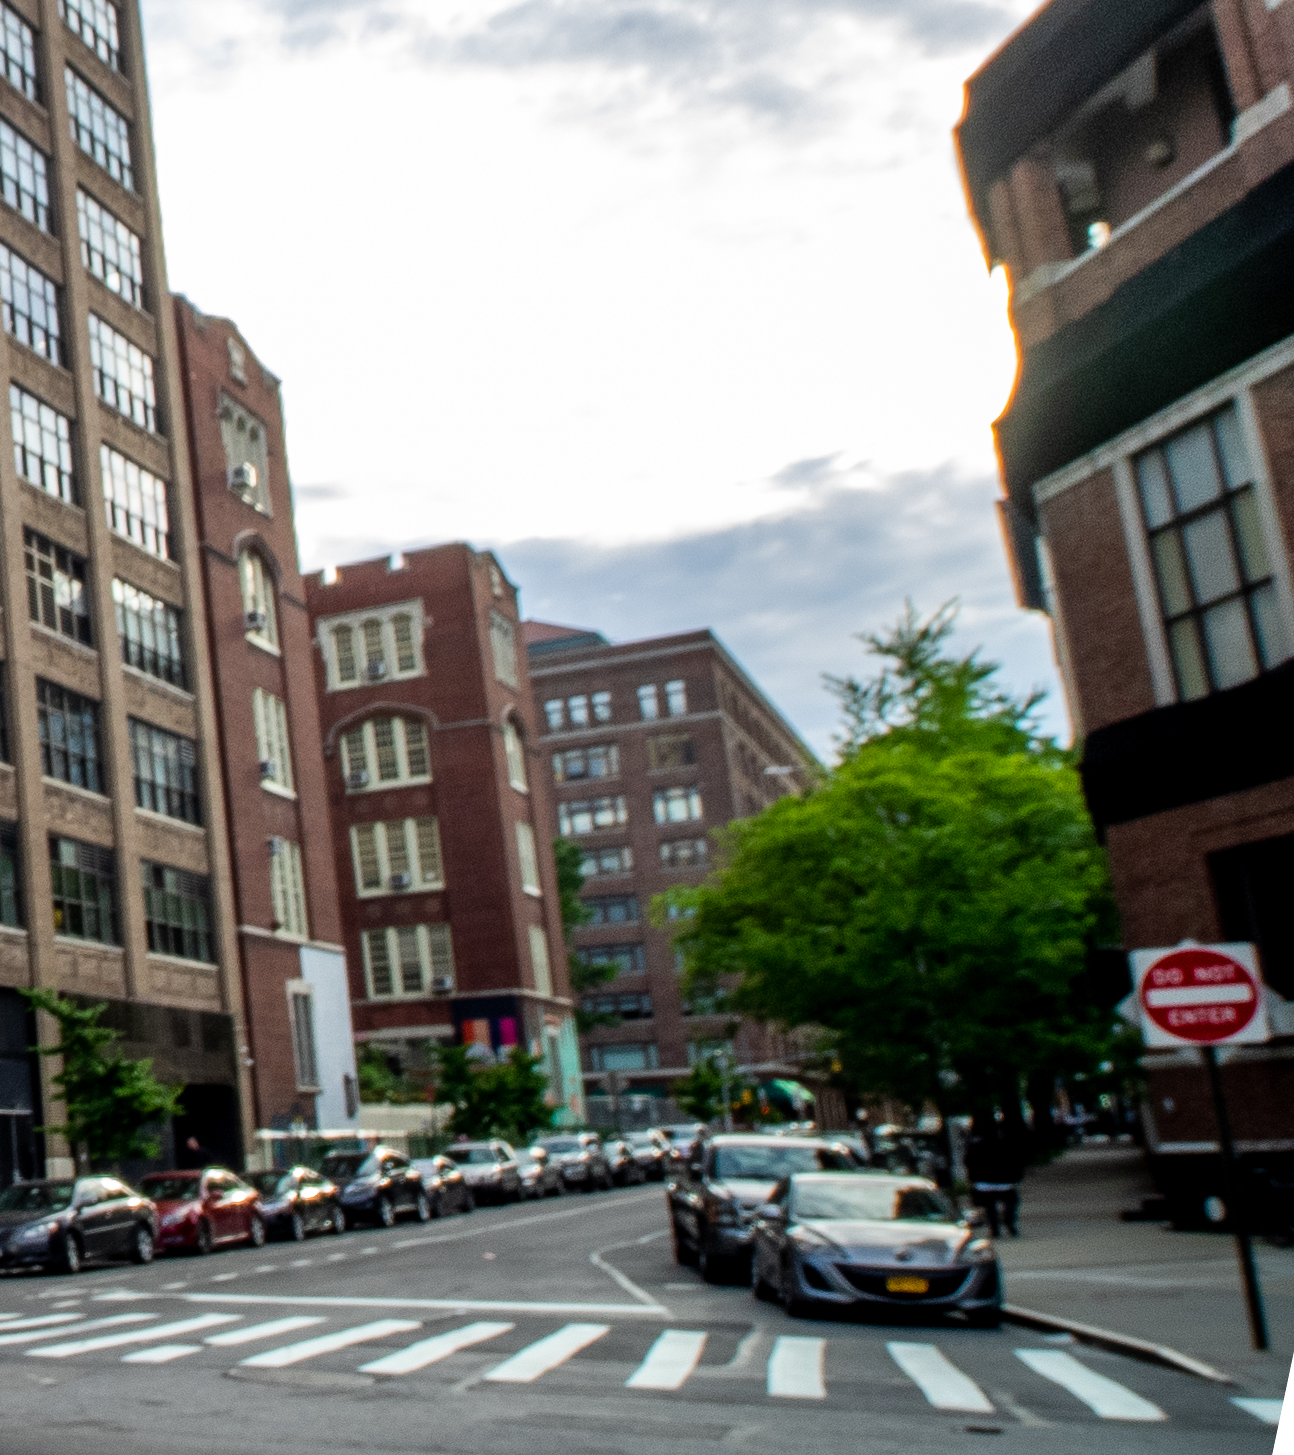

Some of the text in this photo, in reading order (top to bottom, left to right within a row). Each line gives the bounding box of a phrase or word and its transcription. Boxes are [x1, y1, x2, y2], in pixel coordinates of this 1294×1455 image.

[1153, 964, 1235, 985] DO NOT
[1167, 1007, 1237, 1026] ENTER
